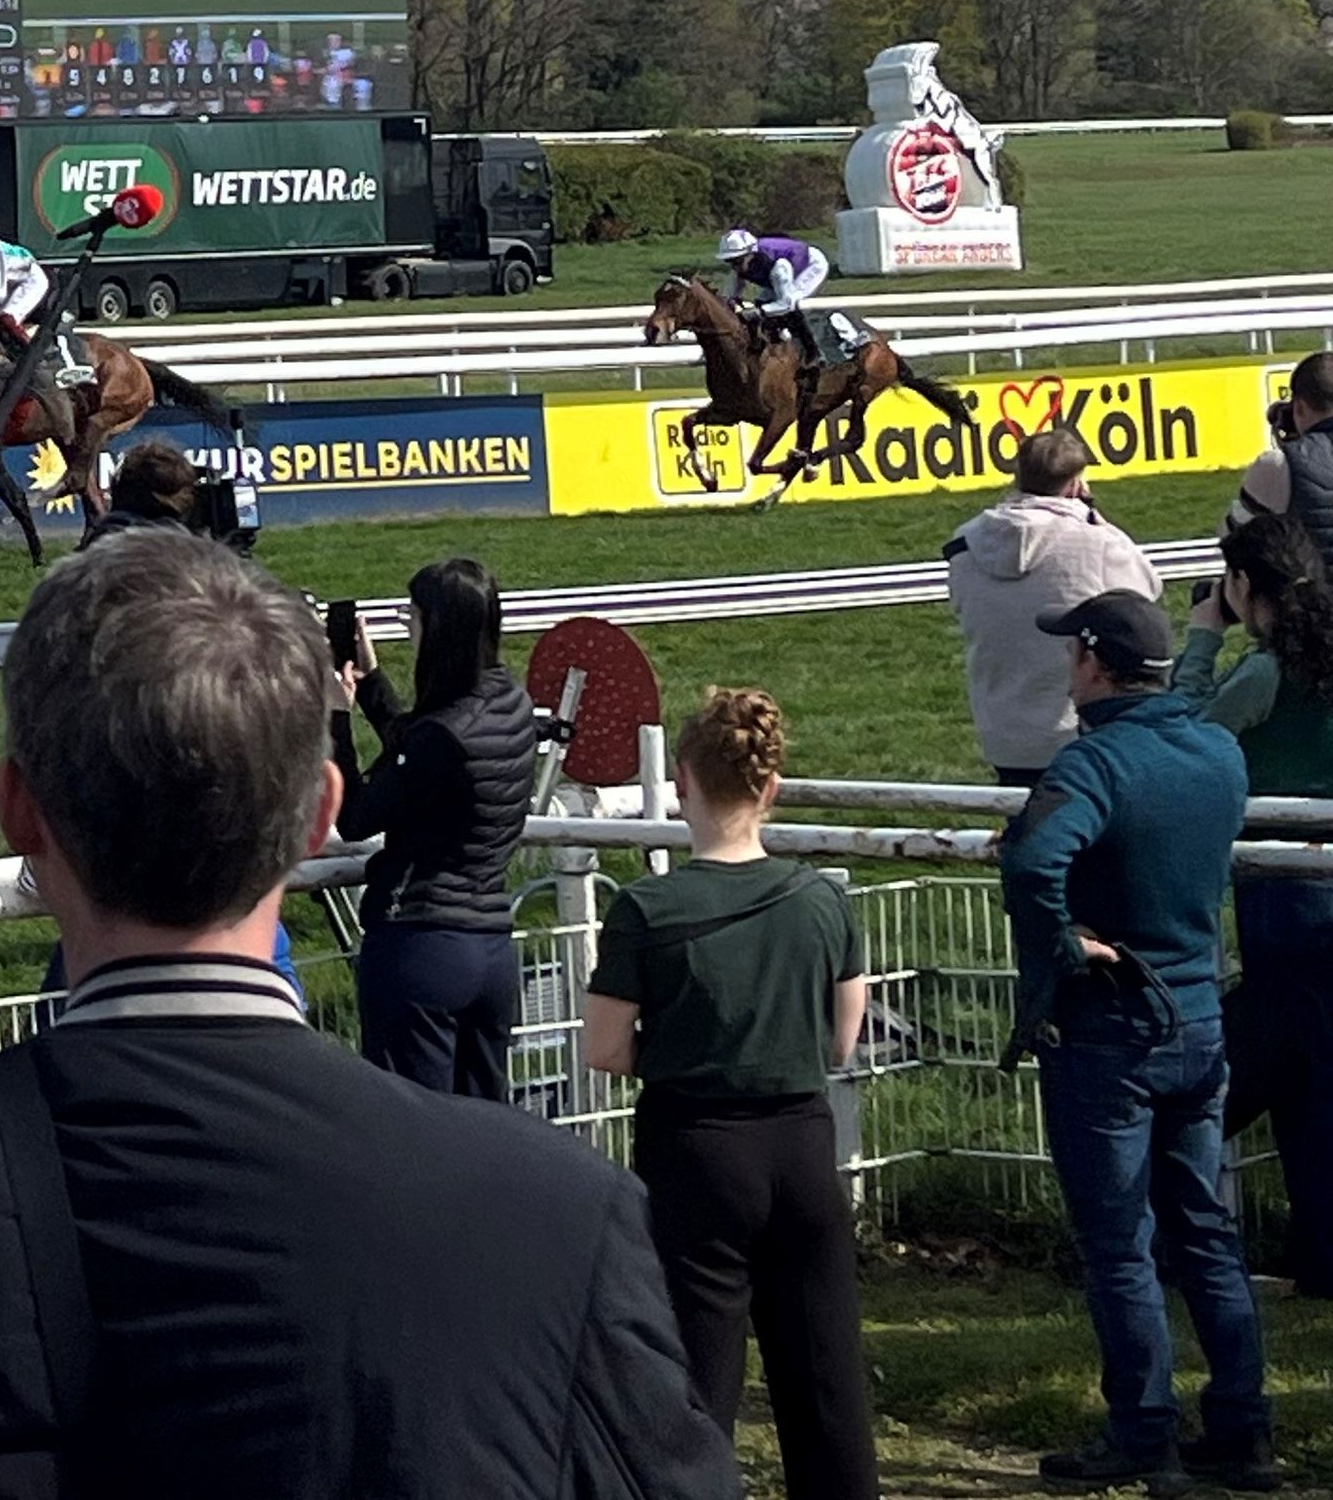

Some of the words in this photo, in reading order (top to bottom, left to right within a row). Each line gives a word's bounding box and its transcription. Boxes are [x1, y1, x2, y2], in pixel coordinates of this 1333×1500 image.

[149, 67, 160, 85] 2
[60, 157, 143, 193] WETT
[192, 167, 377, 206] WETTSTAR.de
[666, 422, 730, 449] Rdio
[825, 389, 1023, 486] Radio
[1048, 376, 1198, 467] Köln
[269, 435, 530, 482] SPIELBANKEN
[675, 450, 727, 479] Kln
